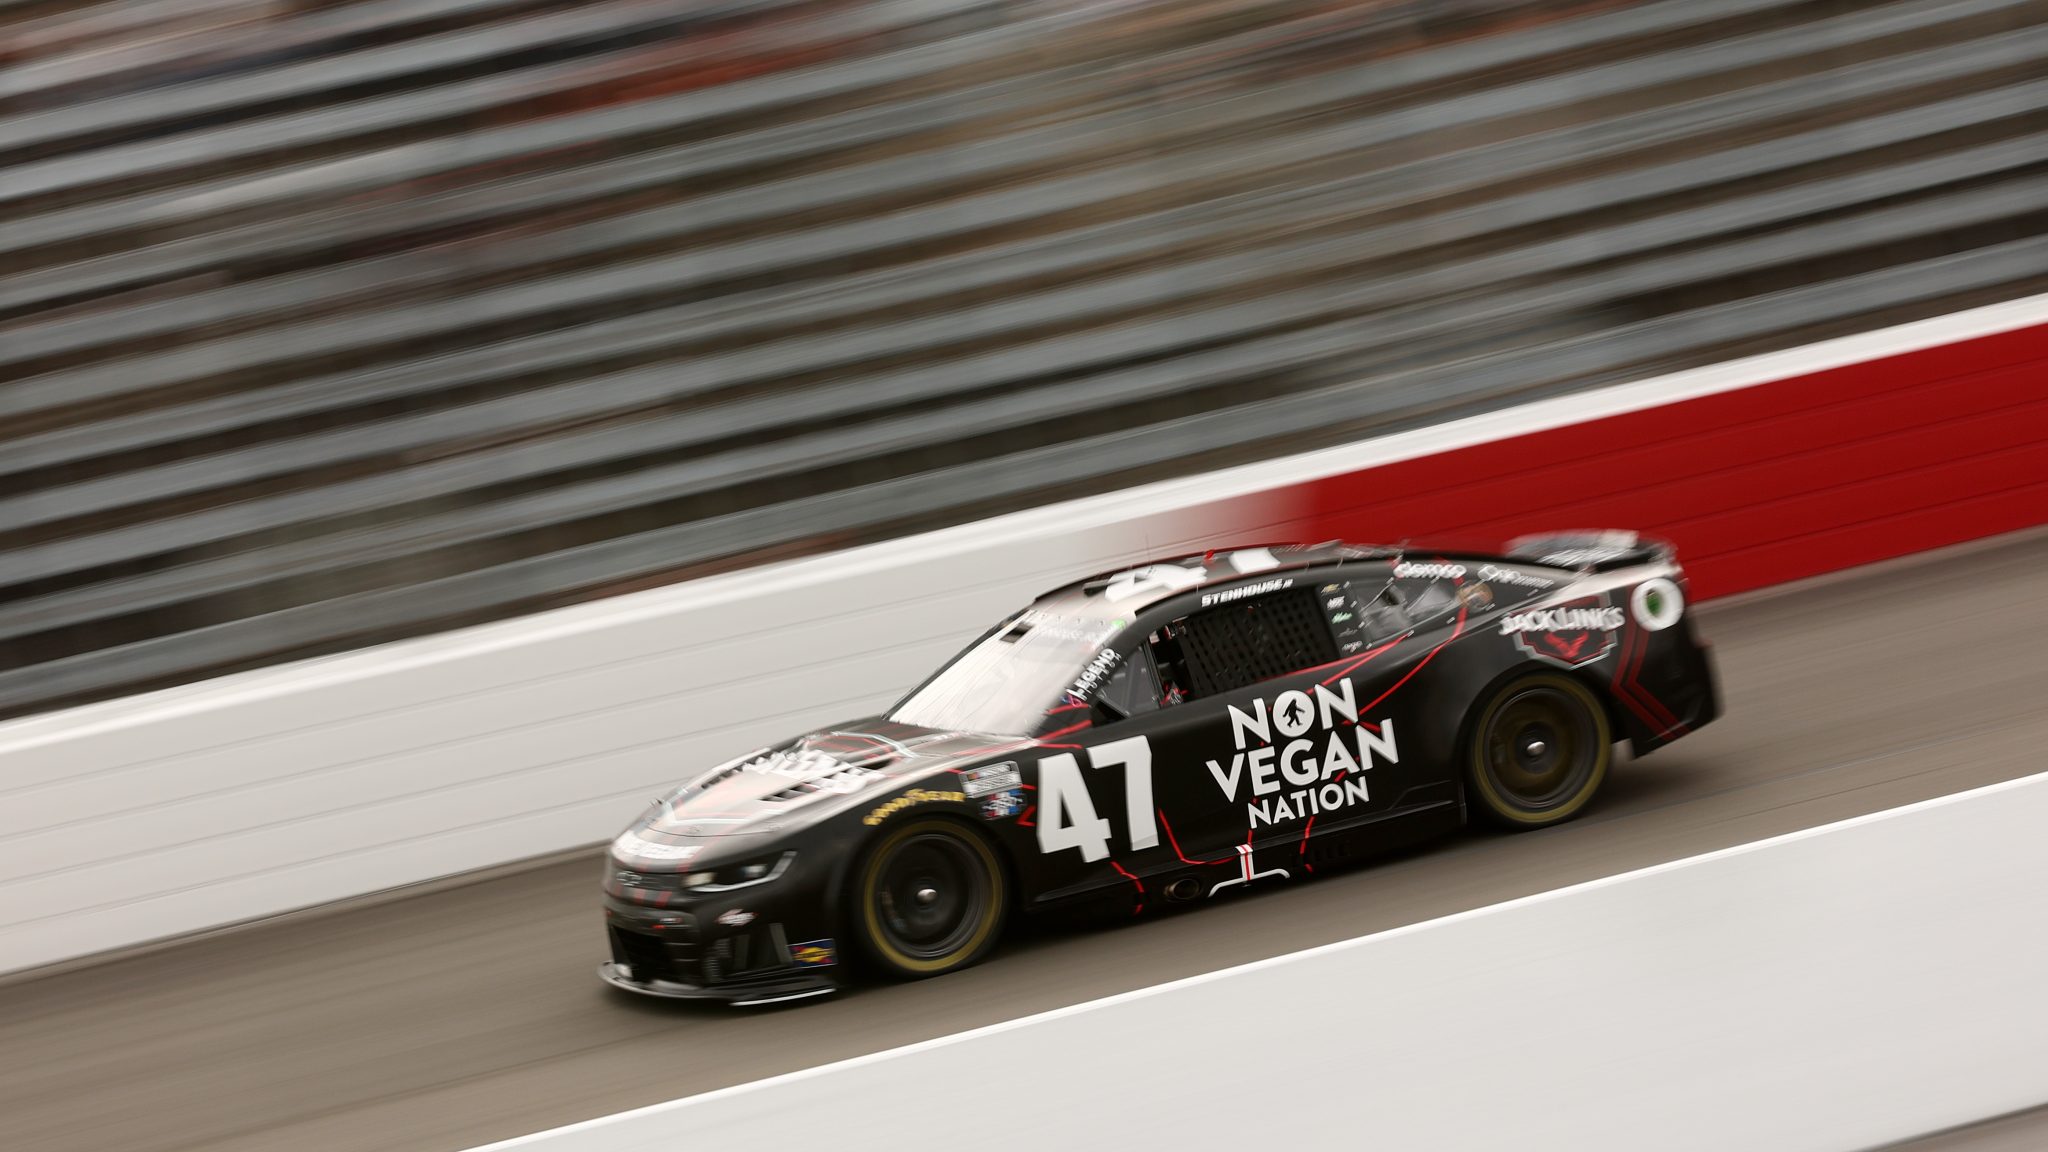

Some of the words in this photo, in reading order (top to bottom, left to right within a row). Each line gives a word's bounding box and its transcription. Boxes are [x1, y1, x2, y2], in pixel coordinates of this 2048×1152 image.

[1201, 578, 1283, 608] STENHOUSE
[1227, 677, 1359, 750] NON
[1205, 717, 1400, 803] VEGAN
[1036, 734, 1160, 863] 47
[1247, 775, 1370, 829] NATION
